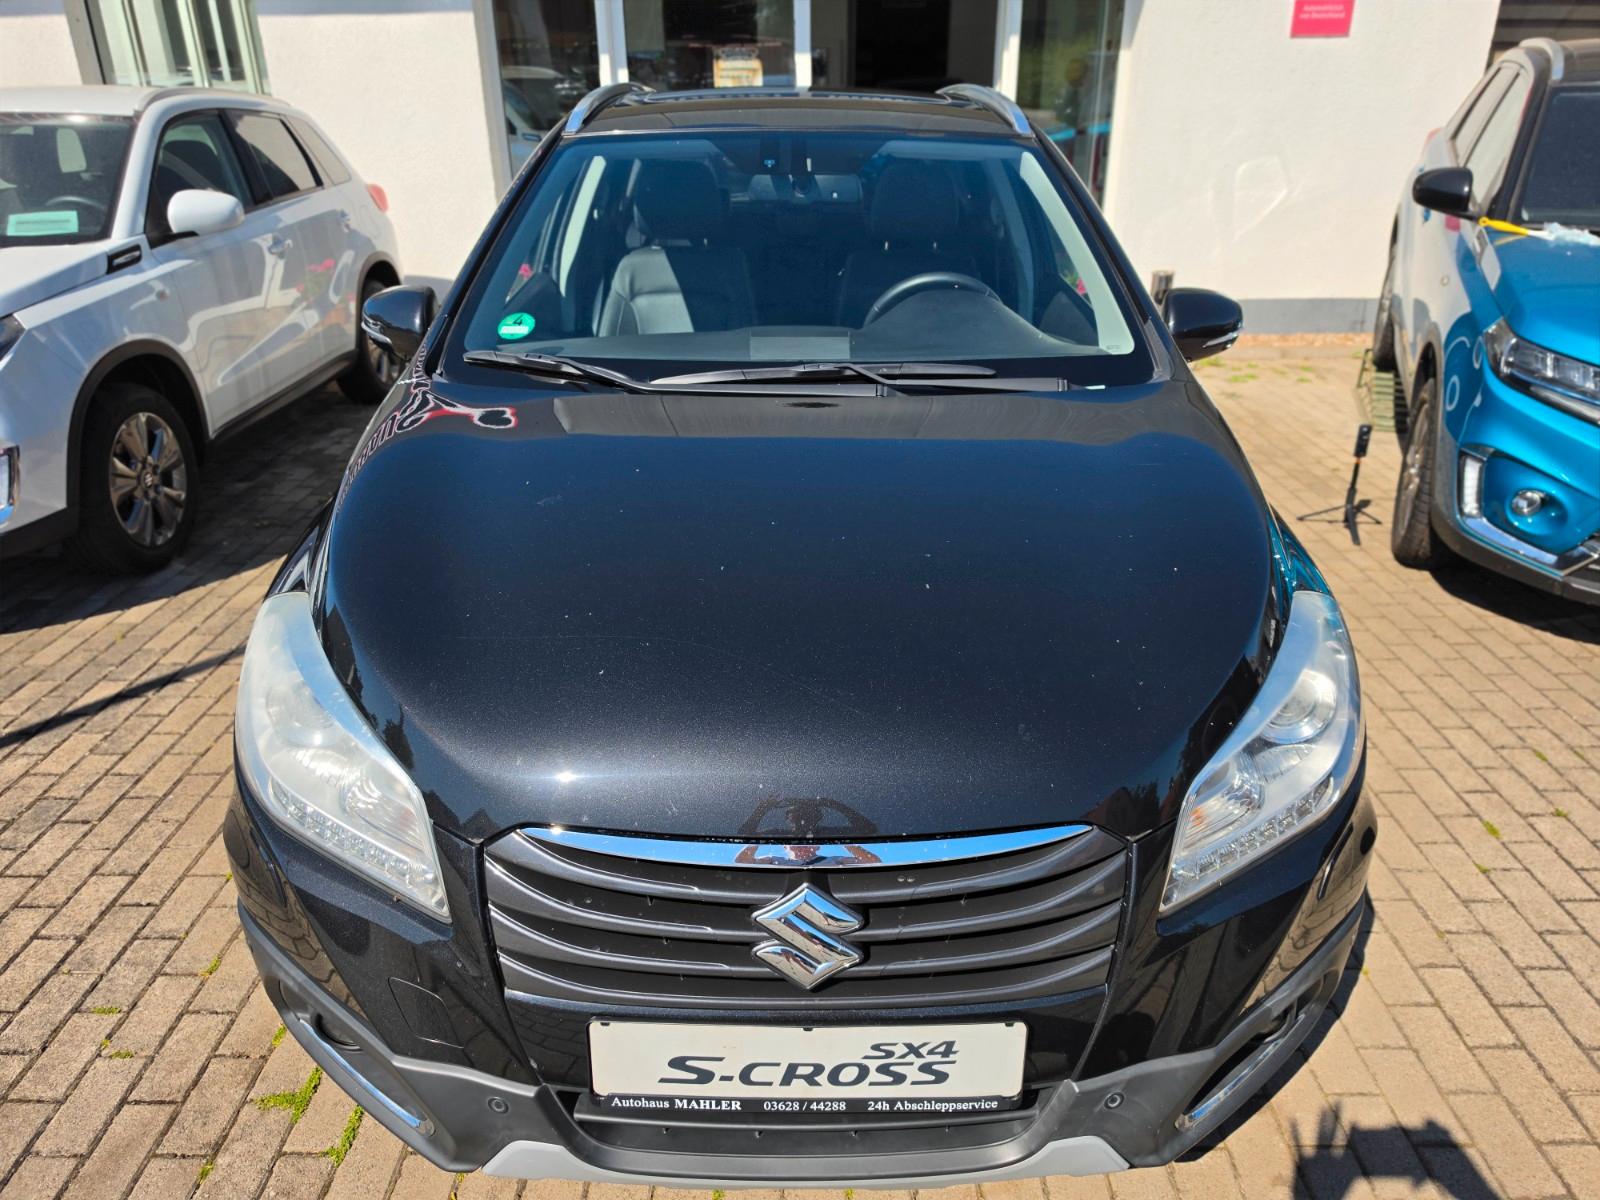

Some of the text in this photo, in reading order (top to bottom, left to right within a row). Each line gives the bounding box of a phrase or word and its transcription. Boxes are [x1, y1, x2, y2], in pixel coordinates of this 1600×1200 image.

[861, 1040, 960, 1060] SX4
[657, 1055, 957, 1087] S-CROSS
[611, 1096, 670, 1109] Autohaus
[674, 1098, 742, 1111] MAHLER
[867, 1100, 890, 1111] 24h
[894, 1098, 999, 1113] Abschleppservice
